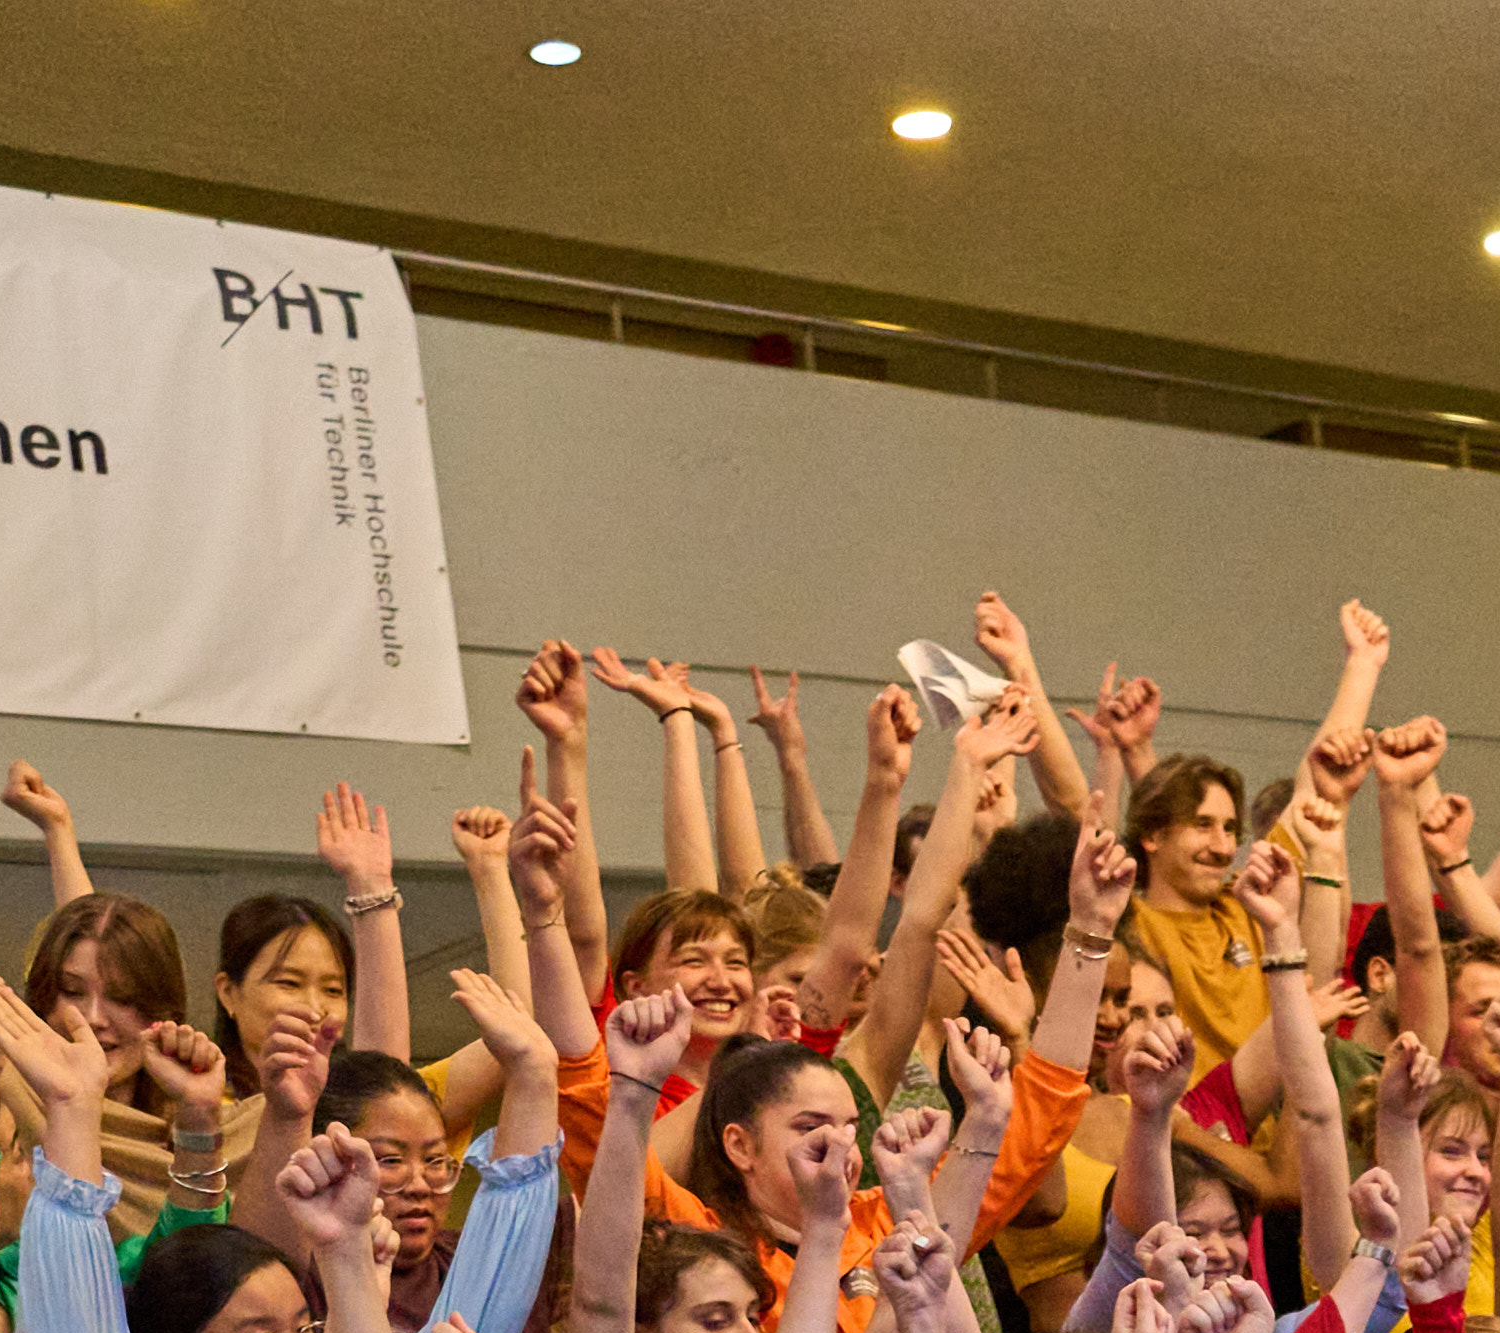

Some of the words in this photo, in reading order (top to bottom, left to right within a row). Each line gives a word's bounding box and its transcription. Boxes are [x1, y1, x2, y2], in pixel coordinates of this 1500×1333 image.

[213, 267, 364, 346] BHT
[314, 361, 338, 402] für
[321, 411, 356, 528] Technik
[347, 365, 378, 482] Berliner
[363, 492, 404, 669] Hochschule
